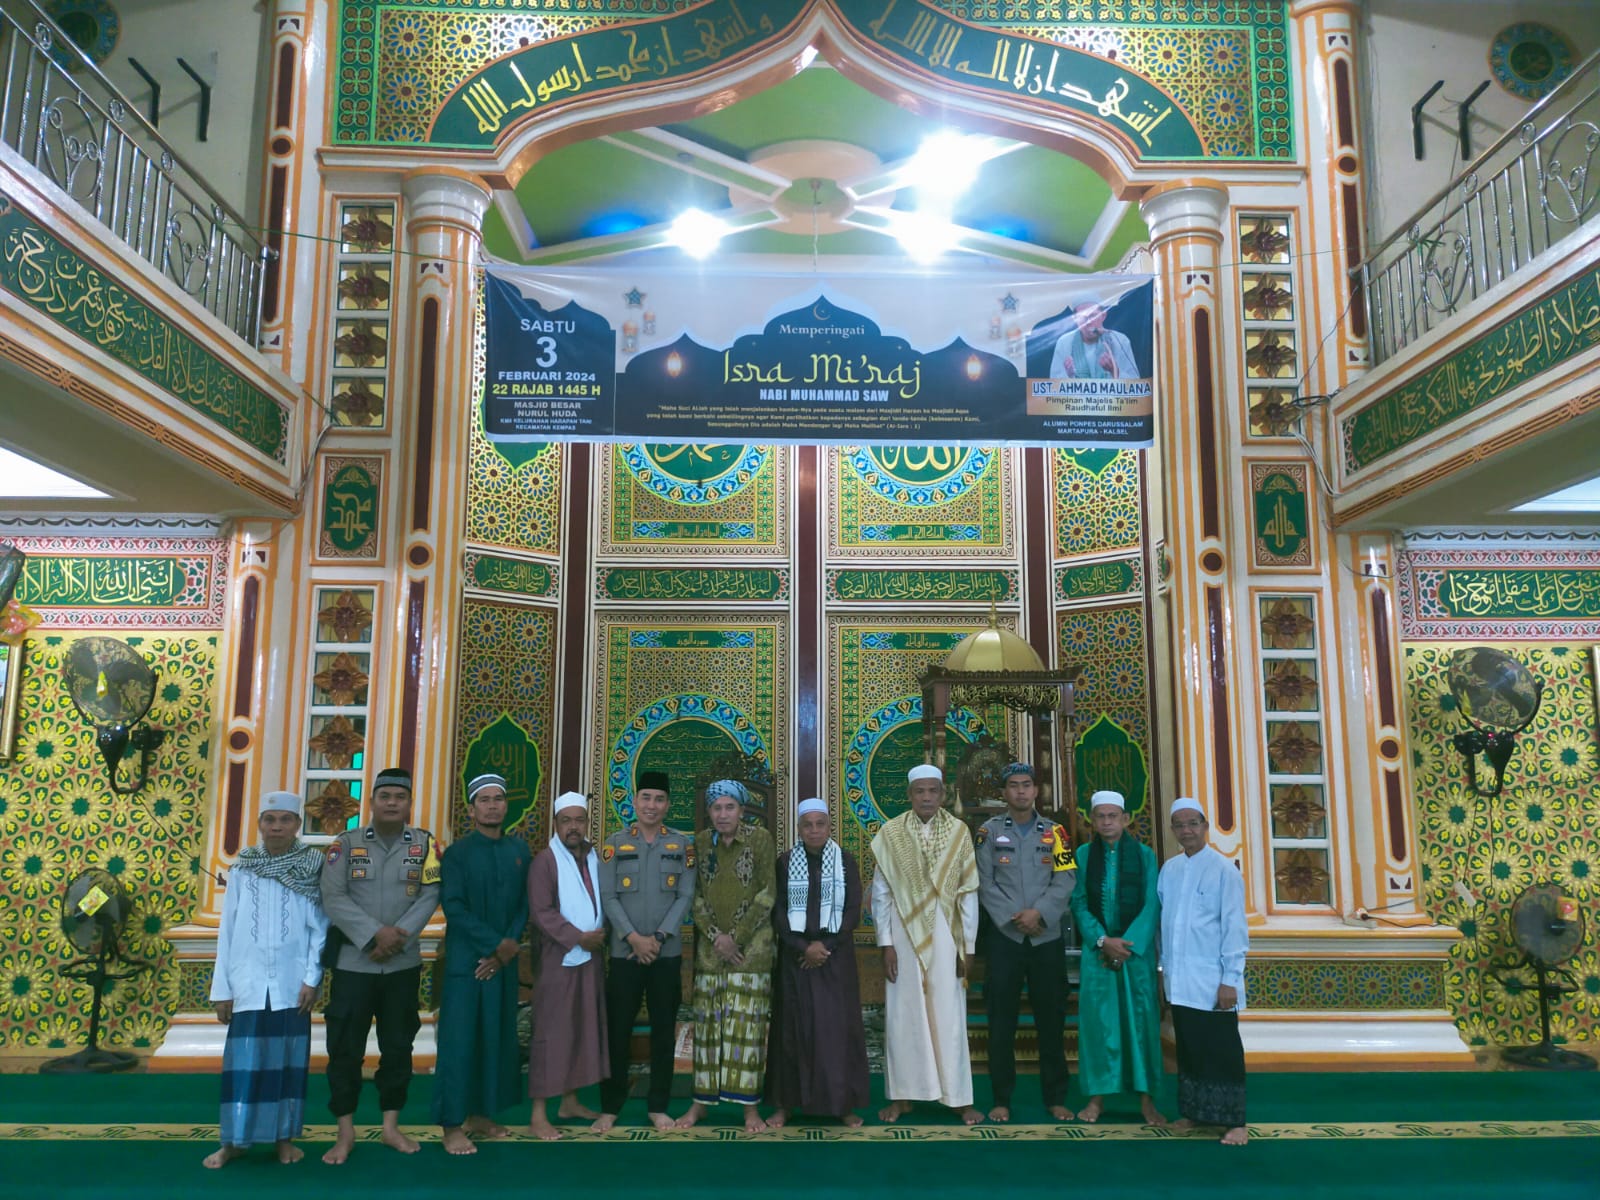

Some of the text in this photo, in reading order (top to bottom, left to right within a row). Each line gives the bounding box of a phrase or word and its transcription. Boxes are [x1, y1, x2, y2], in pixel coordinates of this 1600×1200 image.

[520, 318, 576, 334] SABTU
[778, 324, 865, 338] Memperingati
[536, 336, 558, 368] 3
[498, 371, 596, 382] FEBRUARI 2024
[723, 350, 921, 399] Isra Mi'raj
[492, 384, 601, 396] 22 RAJAB 1445 H
[1059, 381, 1097, 394] AHMAD
[1100, 382, 1152, 394] MAULANA
[759, 388, 890, 402] NABI MUHAMMAD SAW
[1046, 397, 1084, 405] Pimpinan
[1086, 397, 1113, 406] Majelis
[513, 401, 582, 410] MASJID BESAR
[517, 409, 578, 418] NURUL HUDA
[1097, 420, 1144, 428] DARUSSALAM
[1053, 851, 1074, 868] KSP
